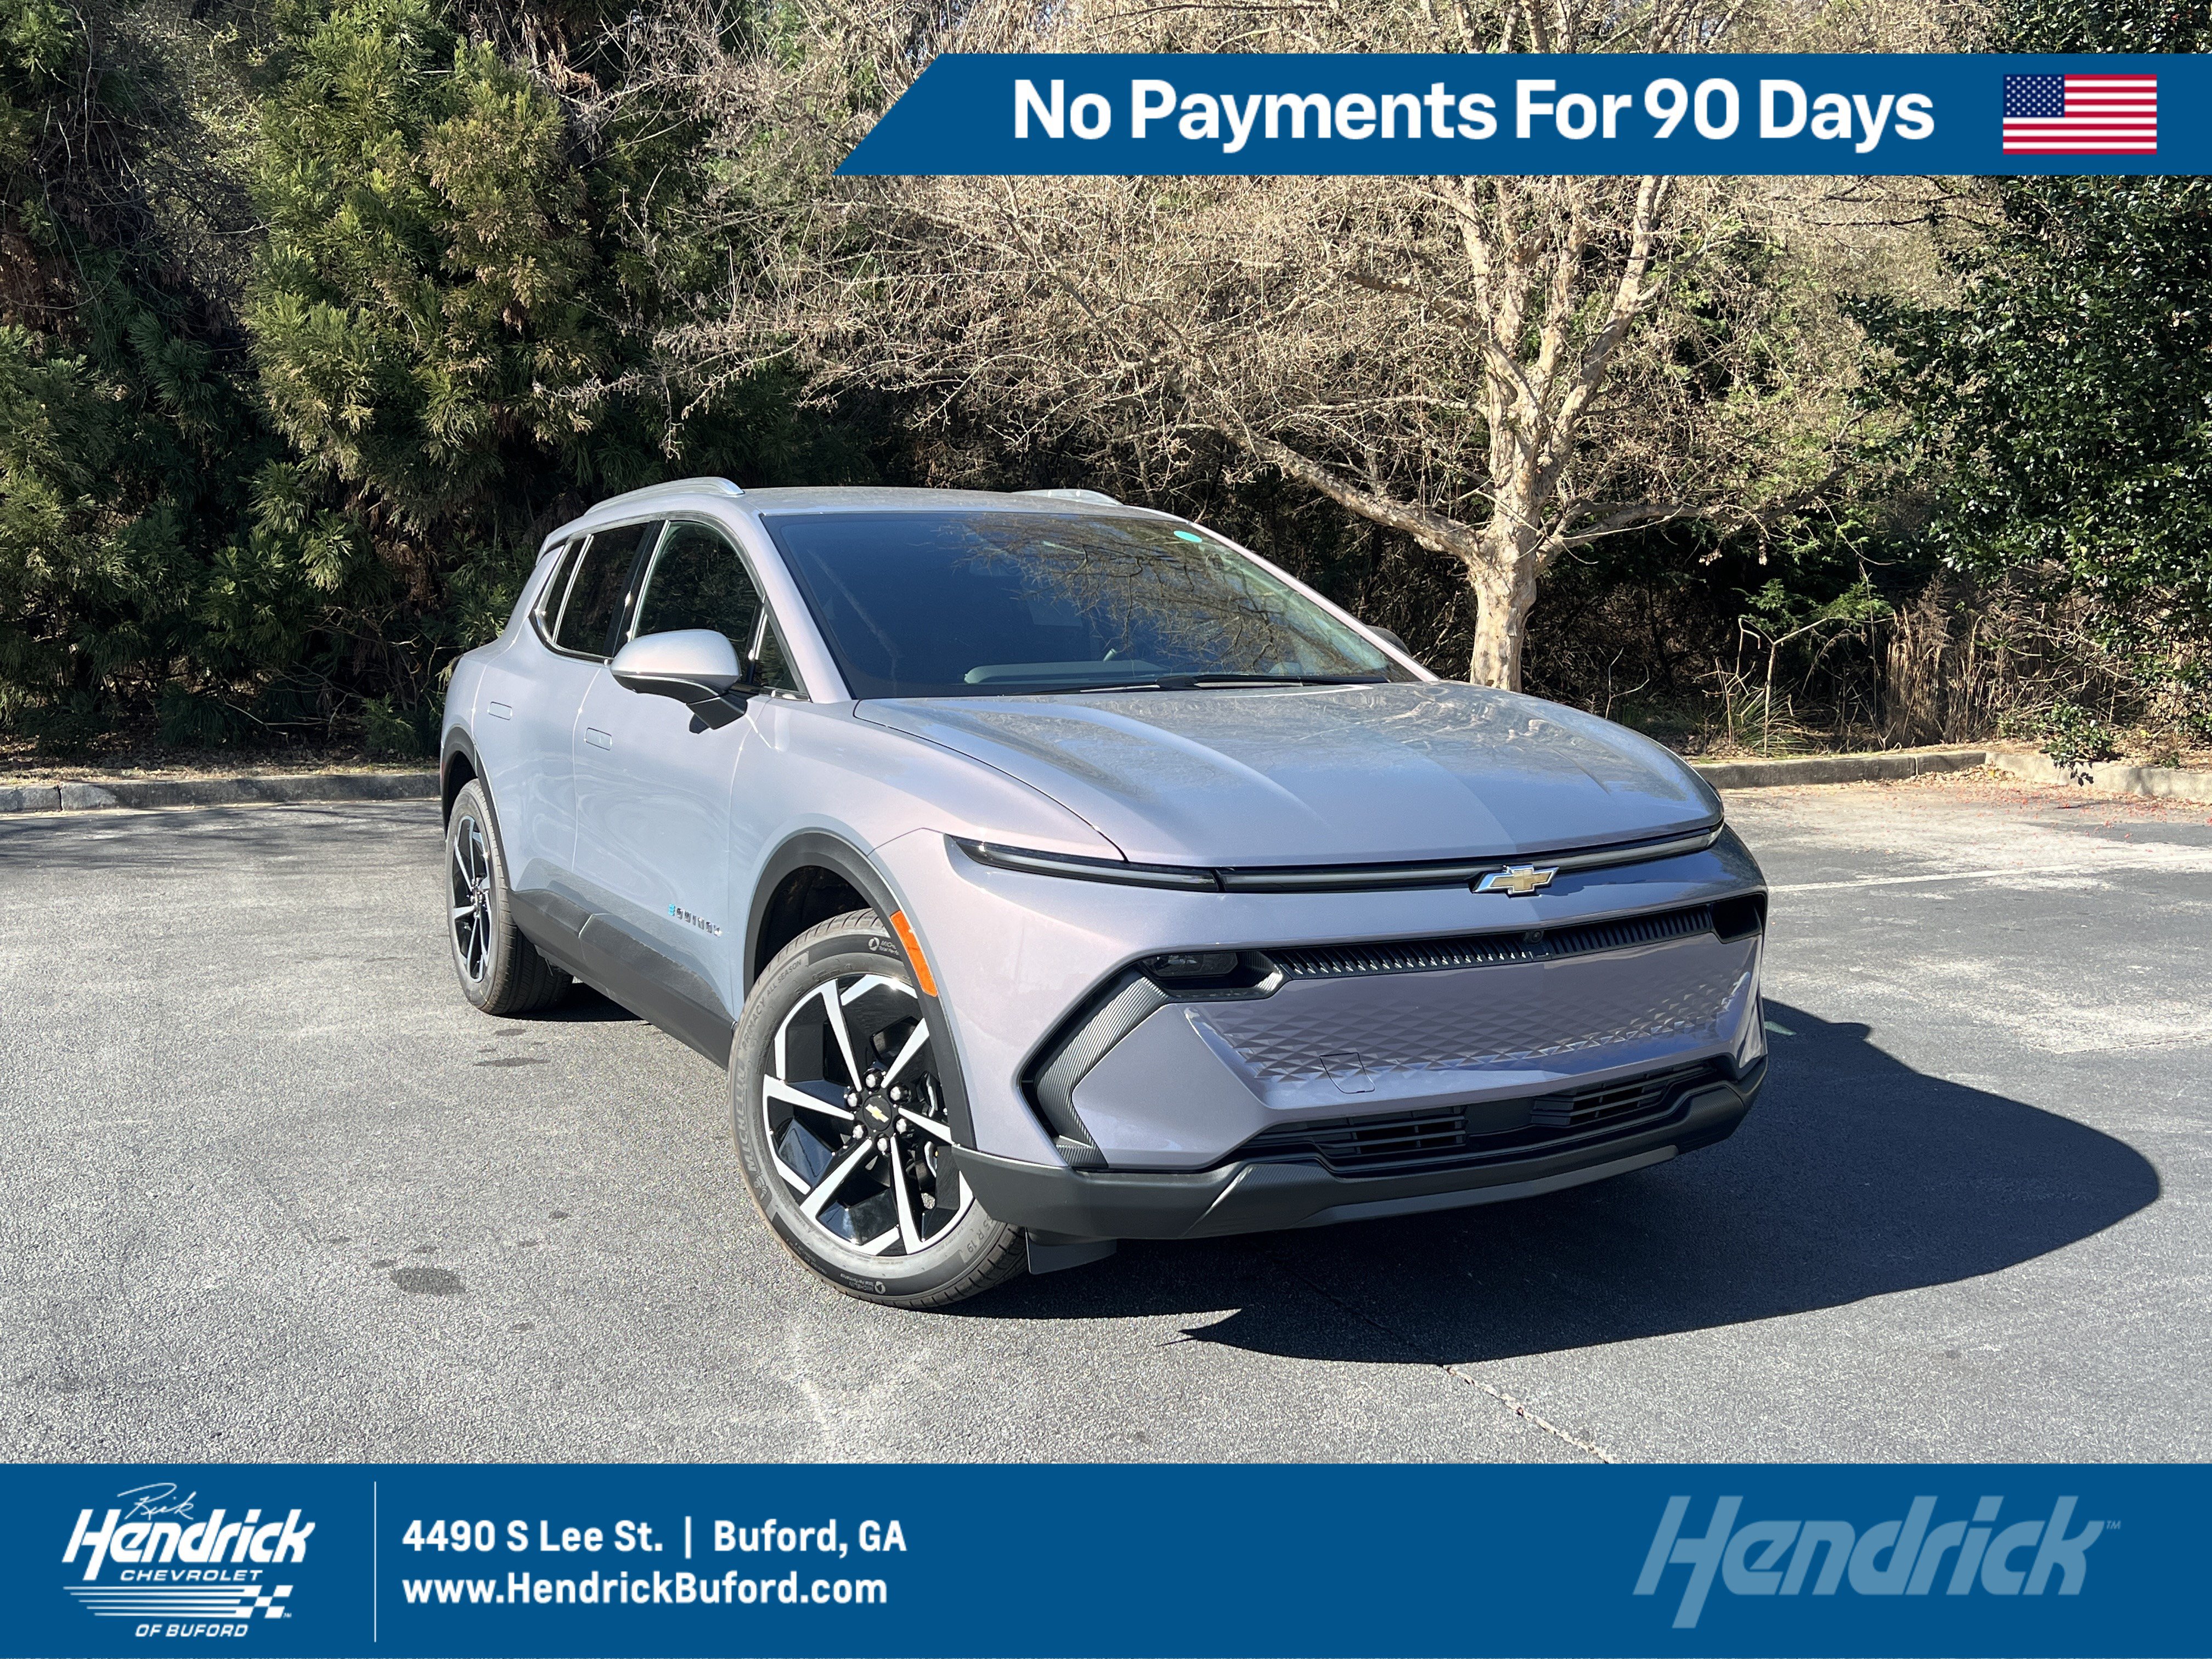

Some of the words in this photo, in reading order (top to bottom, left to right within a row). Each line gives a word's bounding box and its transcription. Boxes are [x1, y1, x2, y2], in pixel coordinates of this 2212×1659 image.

[742, 996, 766, 1052] PRIMACY
[766, 984, 777, 997] ALL
[778, 958, 802, 984] SEASON
[736, 1063, 757, 1172] MICHELIN
